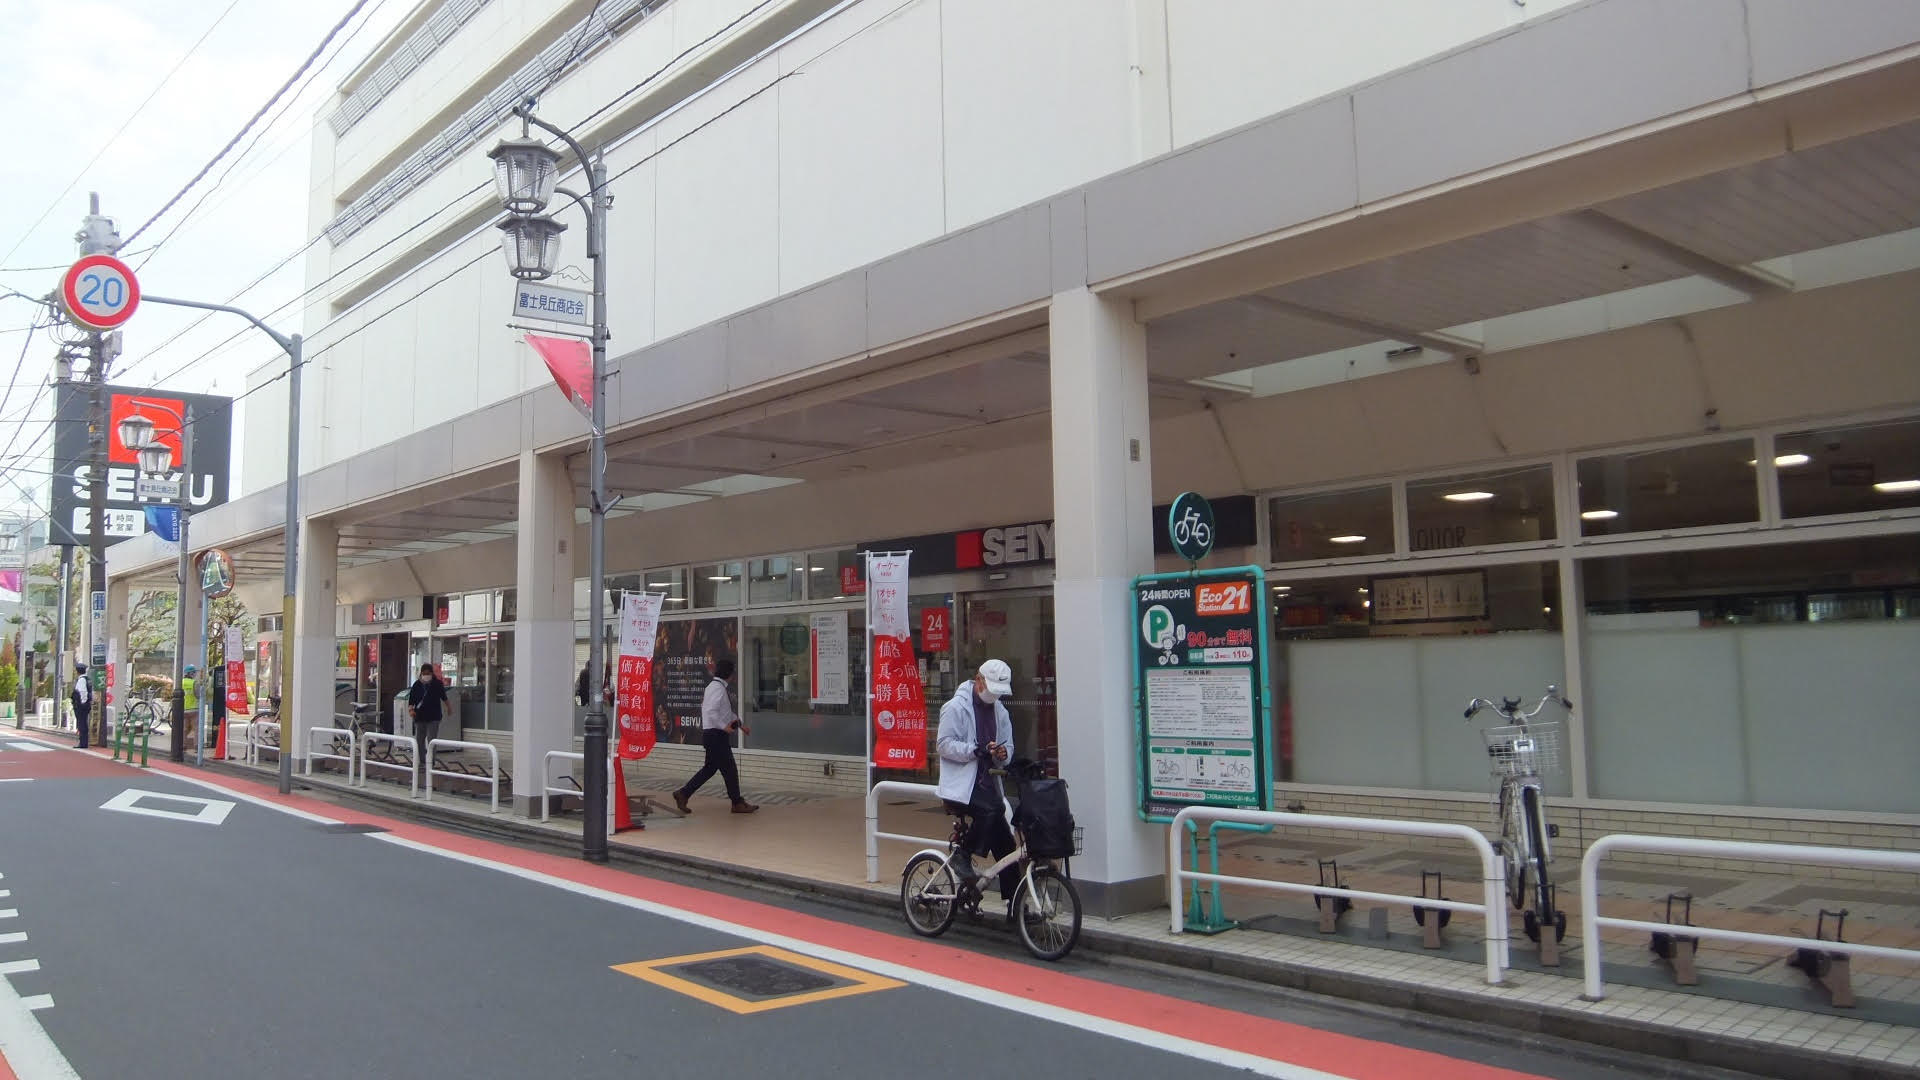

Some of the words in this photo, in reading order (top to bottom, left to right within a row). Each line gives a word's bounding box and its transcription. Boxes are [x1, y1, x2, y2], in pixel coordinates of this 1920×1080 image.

[80, 273, 123, 307] 20
[519, 292, 585, 316] 富士見丘商店会
[983, 523, 1055, 566] SEIY
[1141, 588, 1191, 601] 24時間OPEN
[1200, 587, 1223, 603] Eco
[1221, 585, 1248, 611] 21
[1198, 603, 1222, 612] Station
[927, 614, 943, 631] 24
[1149, 610, 1169, 643] P
[621, 659, 646, 675] 価格
[879, 662, 918, 680] 真っ向
[680, 716, 701, 726] SEIYU
[888, 748, 916, 758] SEIYU
